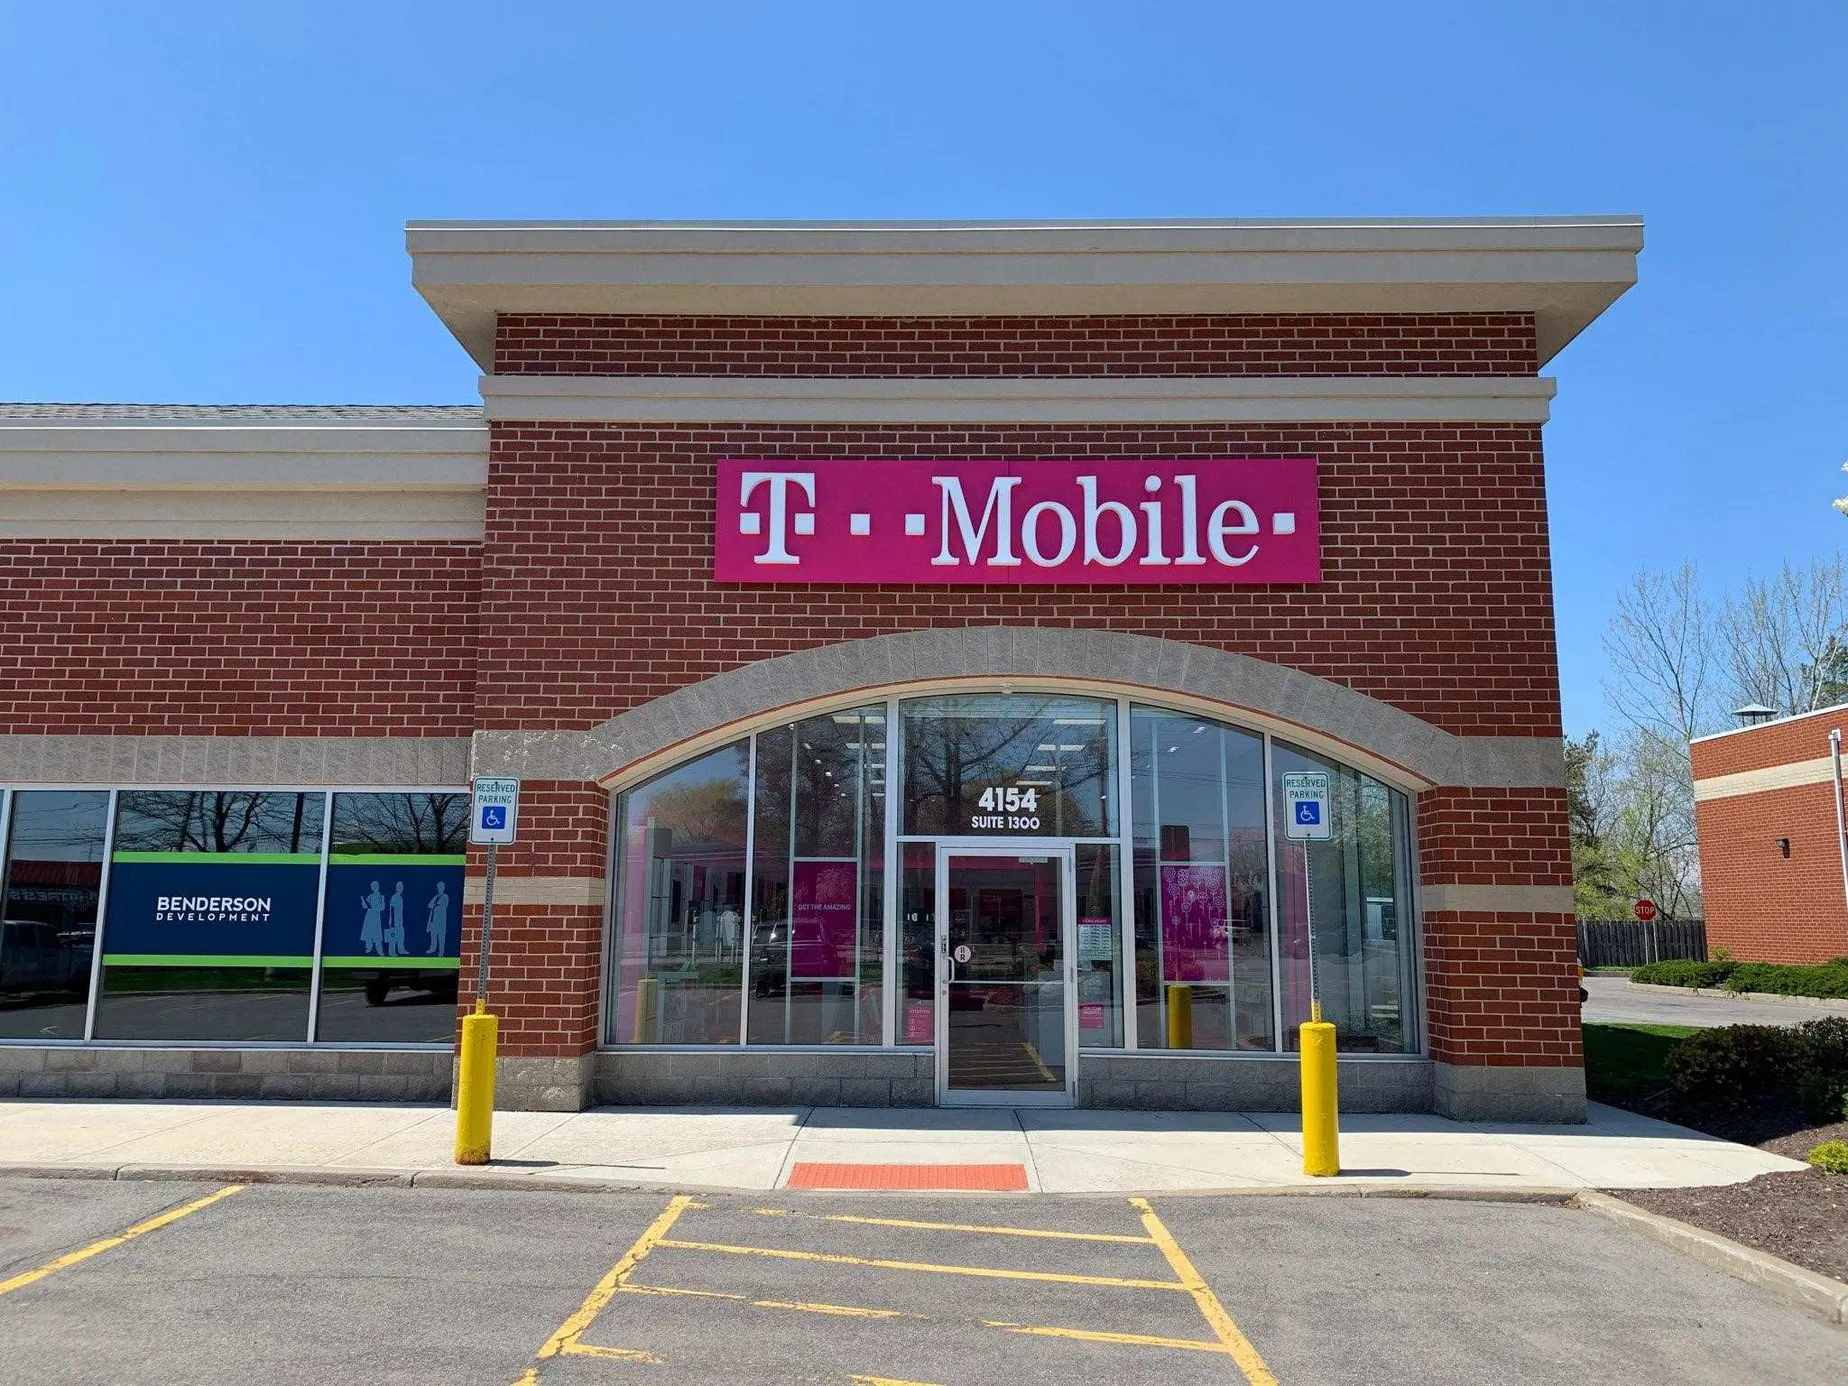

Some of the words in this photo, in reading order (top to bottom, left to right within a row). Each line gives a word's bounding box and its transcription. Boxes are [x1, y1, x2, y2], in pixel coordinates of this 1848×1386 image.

[931, 474, 1260, 567] Mobile
[476, 783, 516, 793] RESERVED
[1286, 779, 1327, 788] RESERVED
[478, 794, 512, 804] PARKING
[978, 787, 1037, 813] 4154
[1289, 790, 1324, 800] PARKING
[971, 815, 1004, 829] SUITE
[1007, 816, 1041, 830] 1300
[157, 896, 272, 912] BENDERSON
[1635, 906, 1655, 915] STOP
[156, 912, 270, 922] DEVELOPMENT
